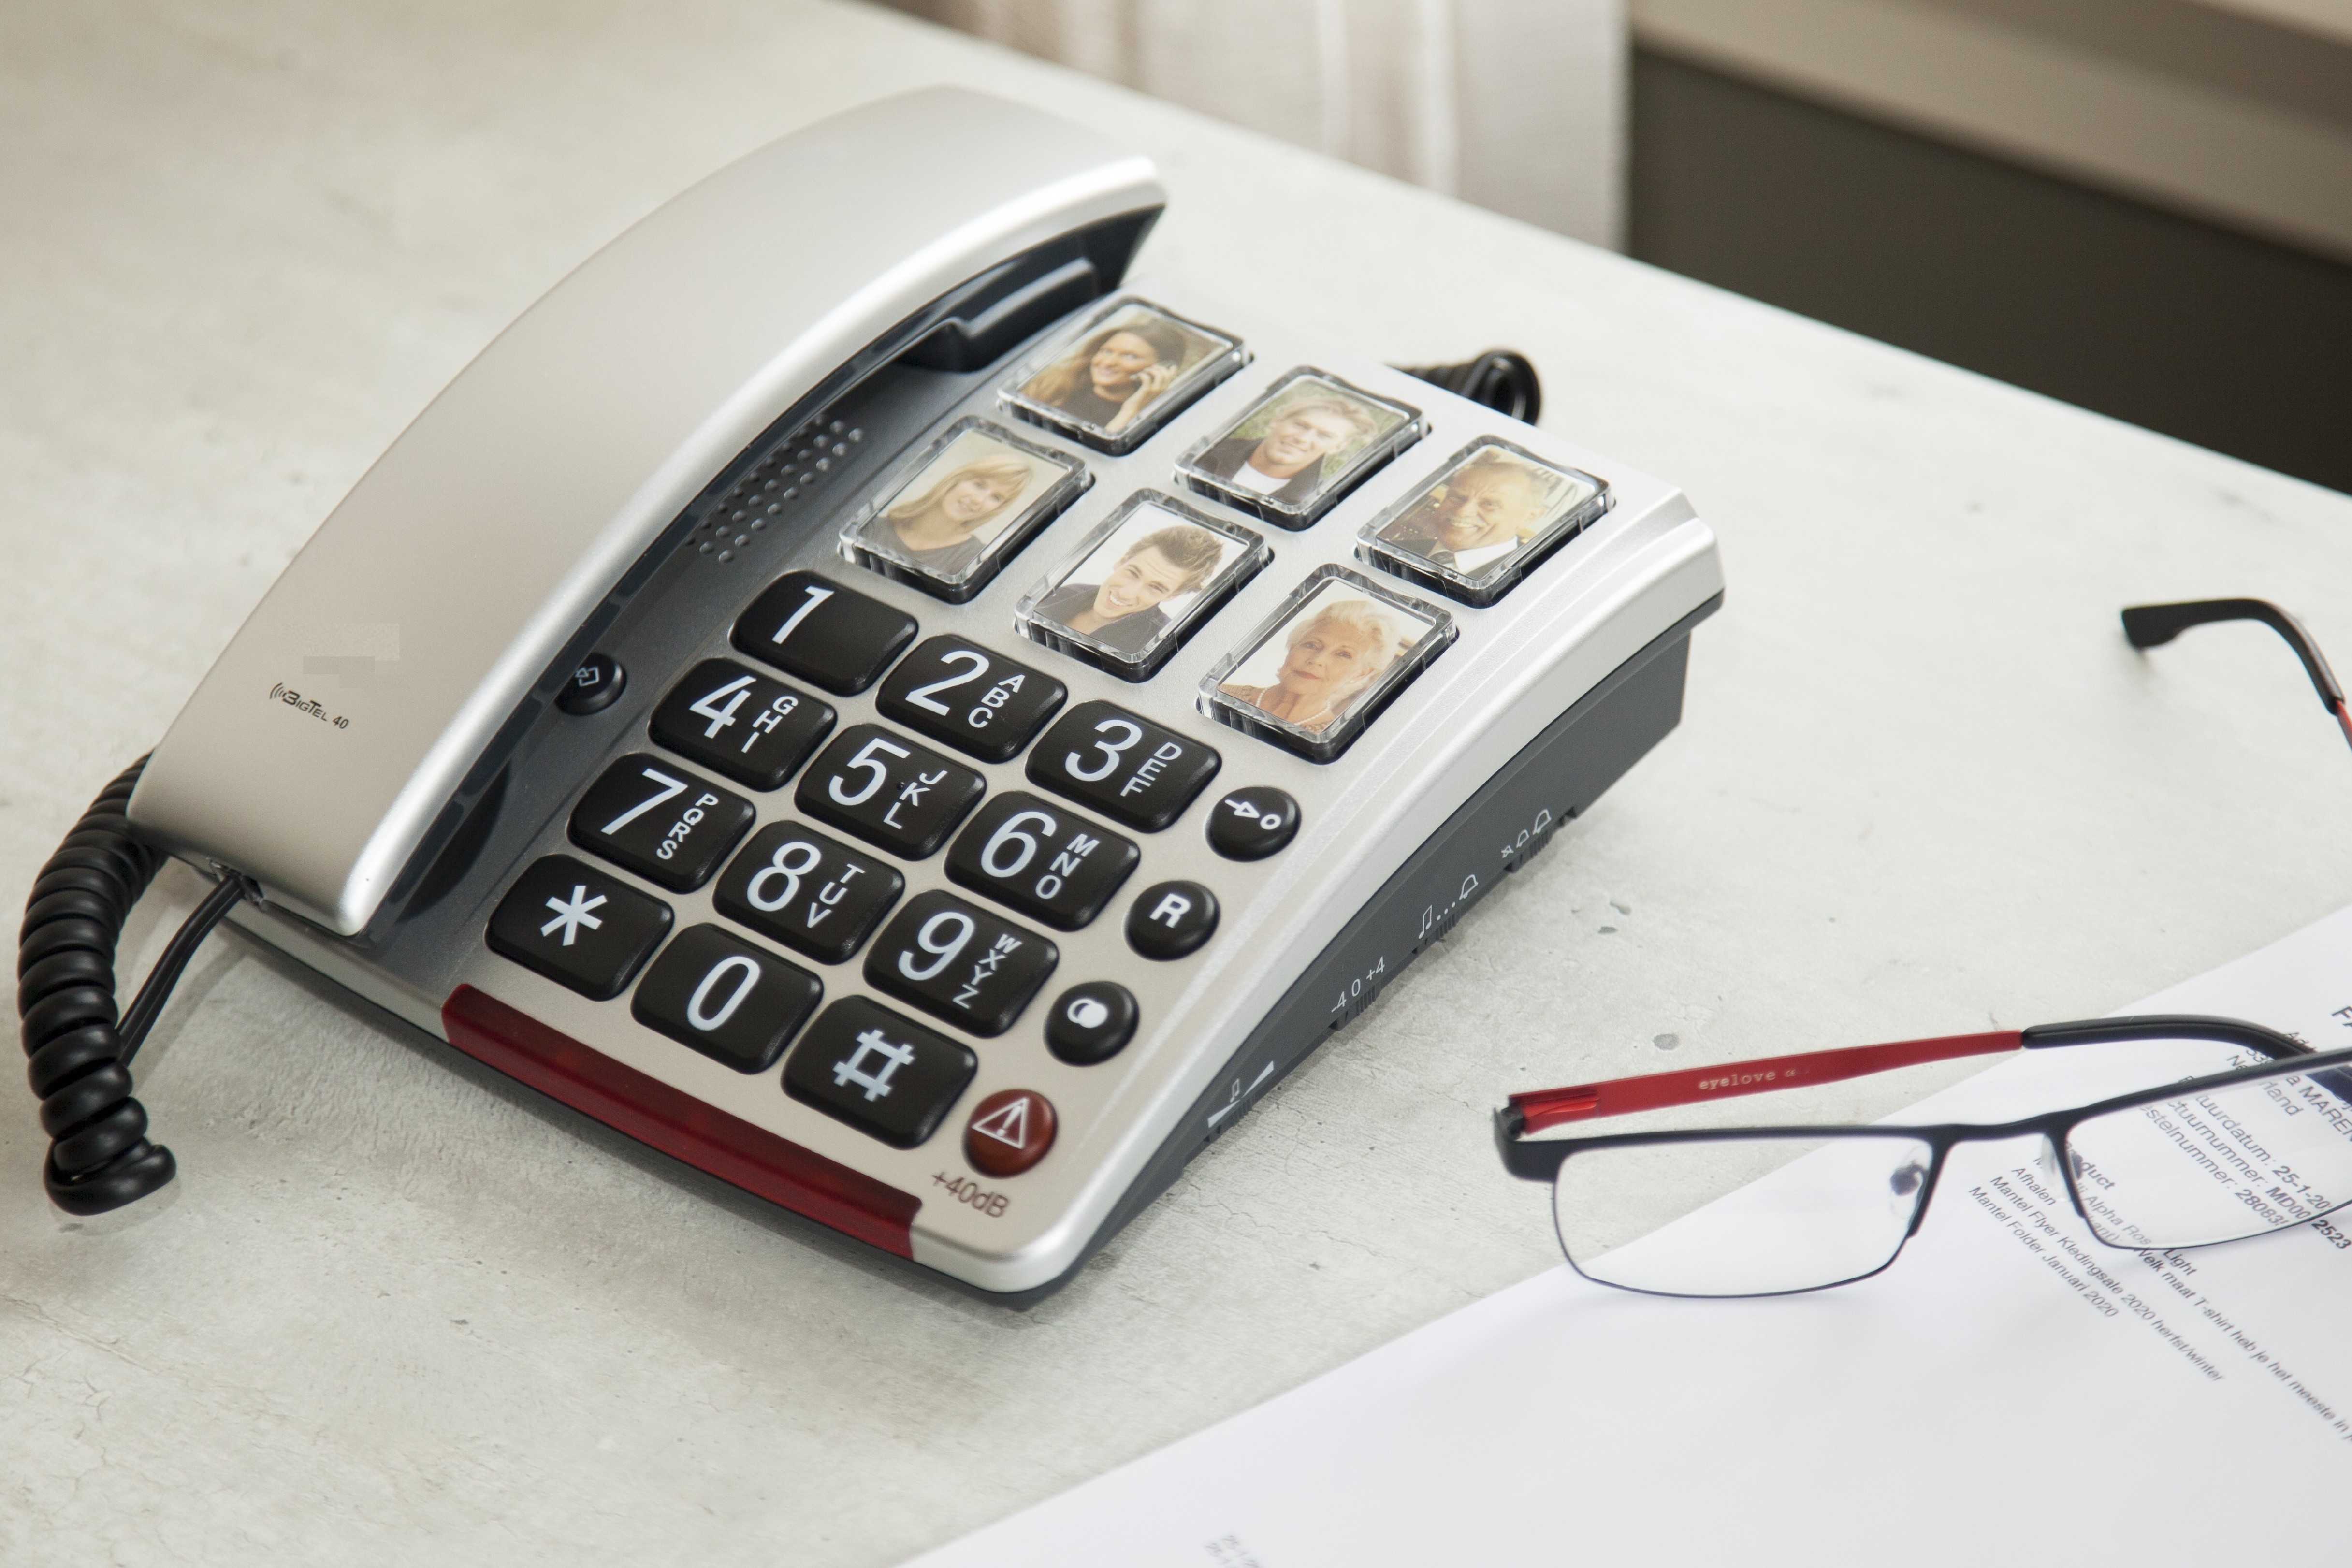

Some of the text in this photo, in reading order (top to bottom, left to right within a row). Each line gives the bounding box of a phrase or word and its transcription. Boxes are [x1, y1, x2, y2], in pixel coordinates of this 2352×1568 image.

[772, 585, 835, 645] 1
[689, 675, 757, 739] 4
[904, 650, 990, 717] 2
[333, 716, 349, 729] 40
[1065, 718, 1143, 782] 3
[600, 768, 689, 836] 7
[828, 738, 911, 806] 5
[746, 841, 822, 912] 8
[980, 810, 1057, 878] 6
[1149, 893, 1191, 929] R
[897, 911, 975, 982] 9
[686, 955, 761, 1032] 0
[1351, 979, 1362, 997] 0
[1699, 1071, 1776, 1090] eyelove
[2141, 1106, 2238, 1189] stelnummer:
[931, 1171, 1010, 1218] +40dB
[2011, 1168, 2056, 1205] Afhalen
[2272, 1165, 2332, 1210] 25-1-20
[1969, 1186, 2119, 1318] Mantel Folder Januari 2020
[2085, 1196, 2123, 1226] Alpha
[2163, 1248, 2197, 1276] Light
[1990, 1176, 2224, 1381] Mantel Flyer Kledingsale 2020 herfst/winter
[2162, 1272, 2196, 1298] maat
[2194, 1297, 2234, 1332] T-shirt
[2230, 1330, 2257, 1351] heb
[2267, 1361, 2293, 1381] het
